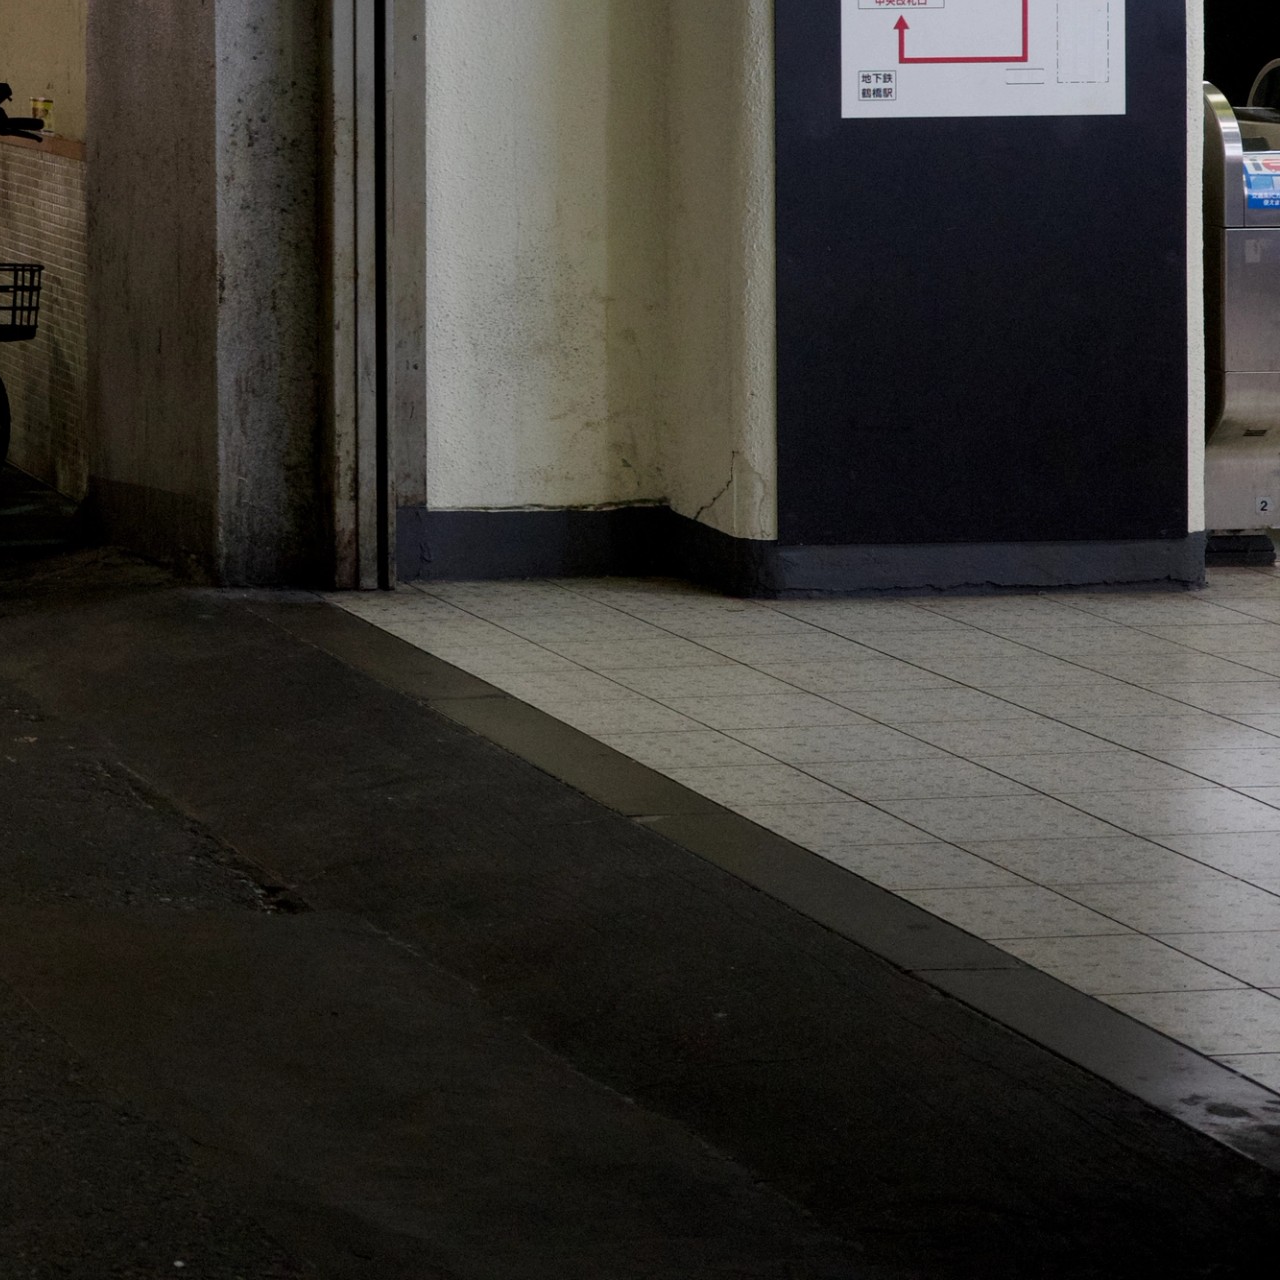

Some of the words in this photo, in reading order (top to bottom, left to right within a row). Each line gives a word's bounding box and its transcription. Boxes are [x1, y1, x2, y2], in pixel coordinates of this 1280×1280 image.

[861, 72, 893, 84] 地下鉄
[861, 87, 893, 99] 鶴橋駅
